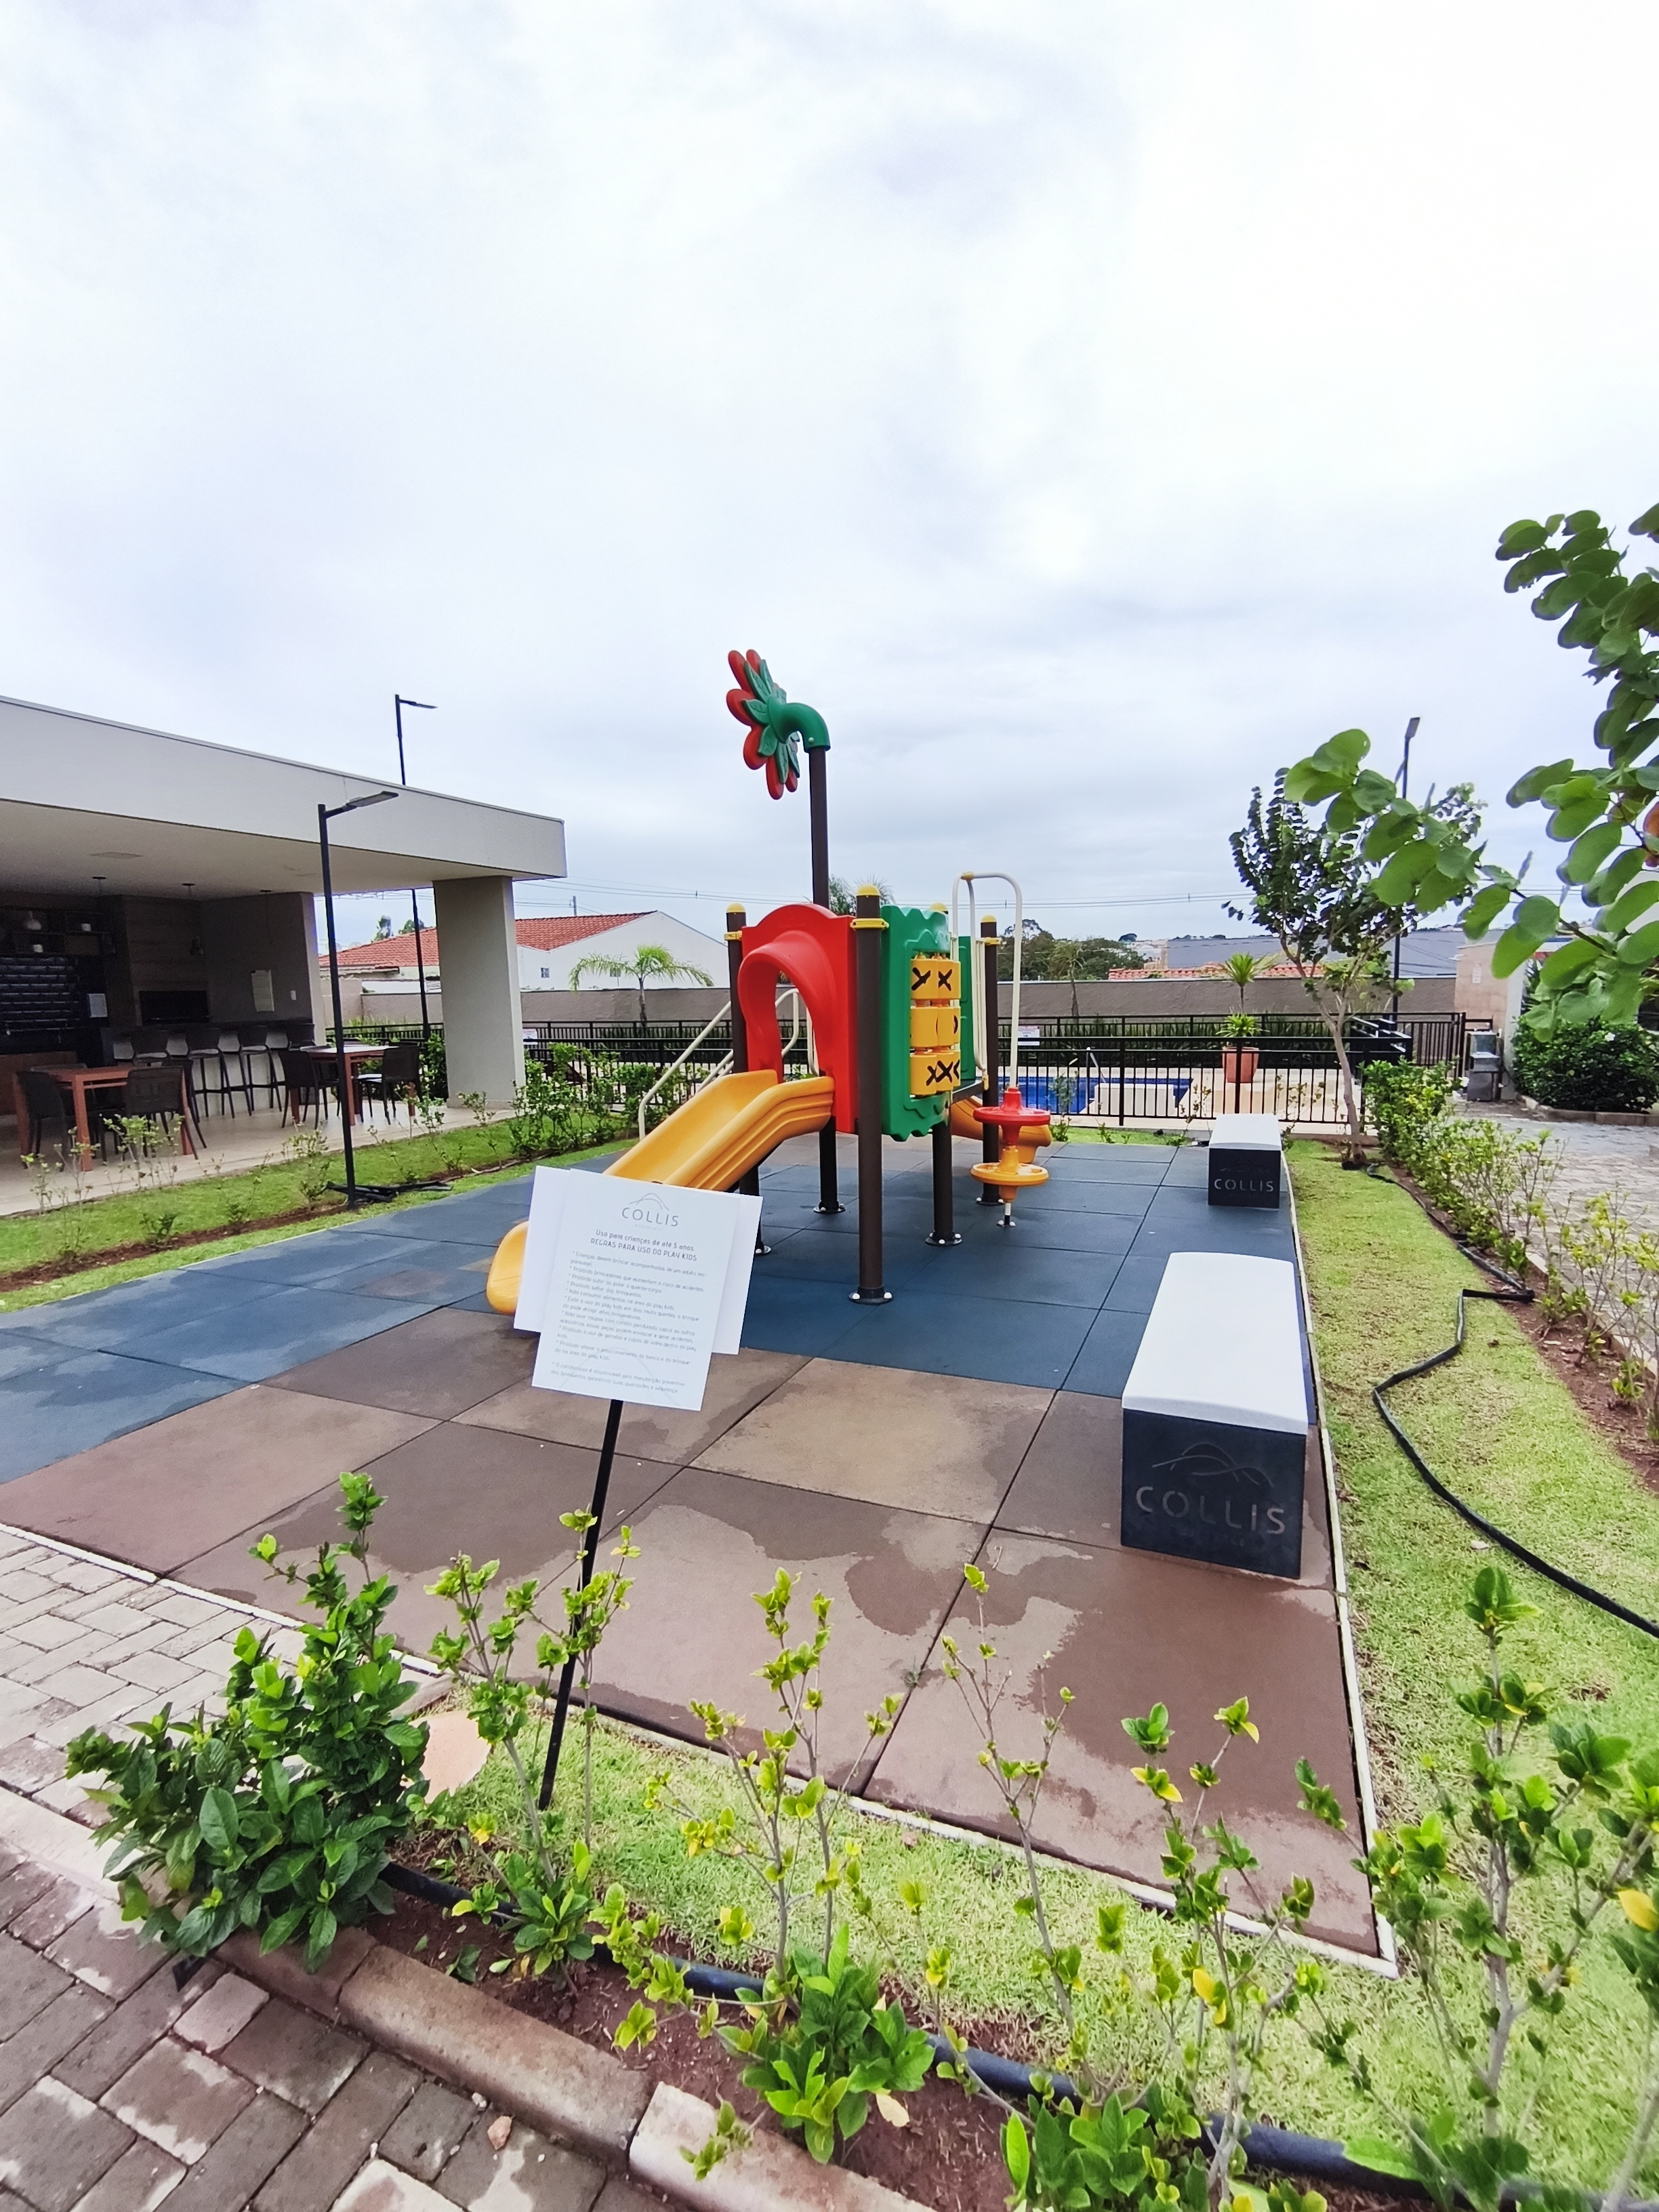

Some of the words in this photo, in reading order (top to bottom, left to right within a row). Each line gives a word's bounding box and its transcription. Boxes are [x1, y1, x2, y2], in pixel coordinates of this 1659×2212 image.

[1214, 1179, 1274, 1192] COLLIS
[621, 1207, 678, 1226] COLLIS
[596, 1229, 607, 1237] Uso
[624, 1235, 650, 1244] crianças
[590, 1237, 616, 1248] REGRAS
[617, 1242, 635, 1251] PARA
[663, 1250, 680, 1258] PLAY
[1135, 1486, 1285, 1534] COLLIS
